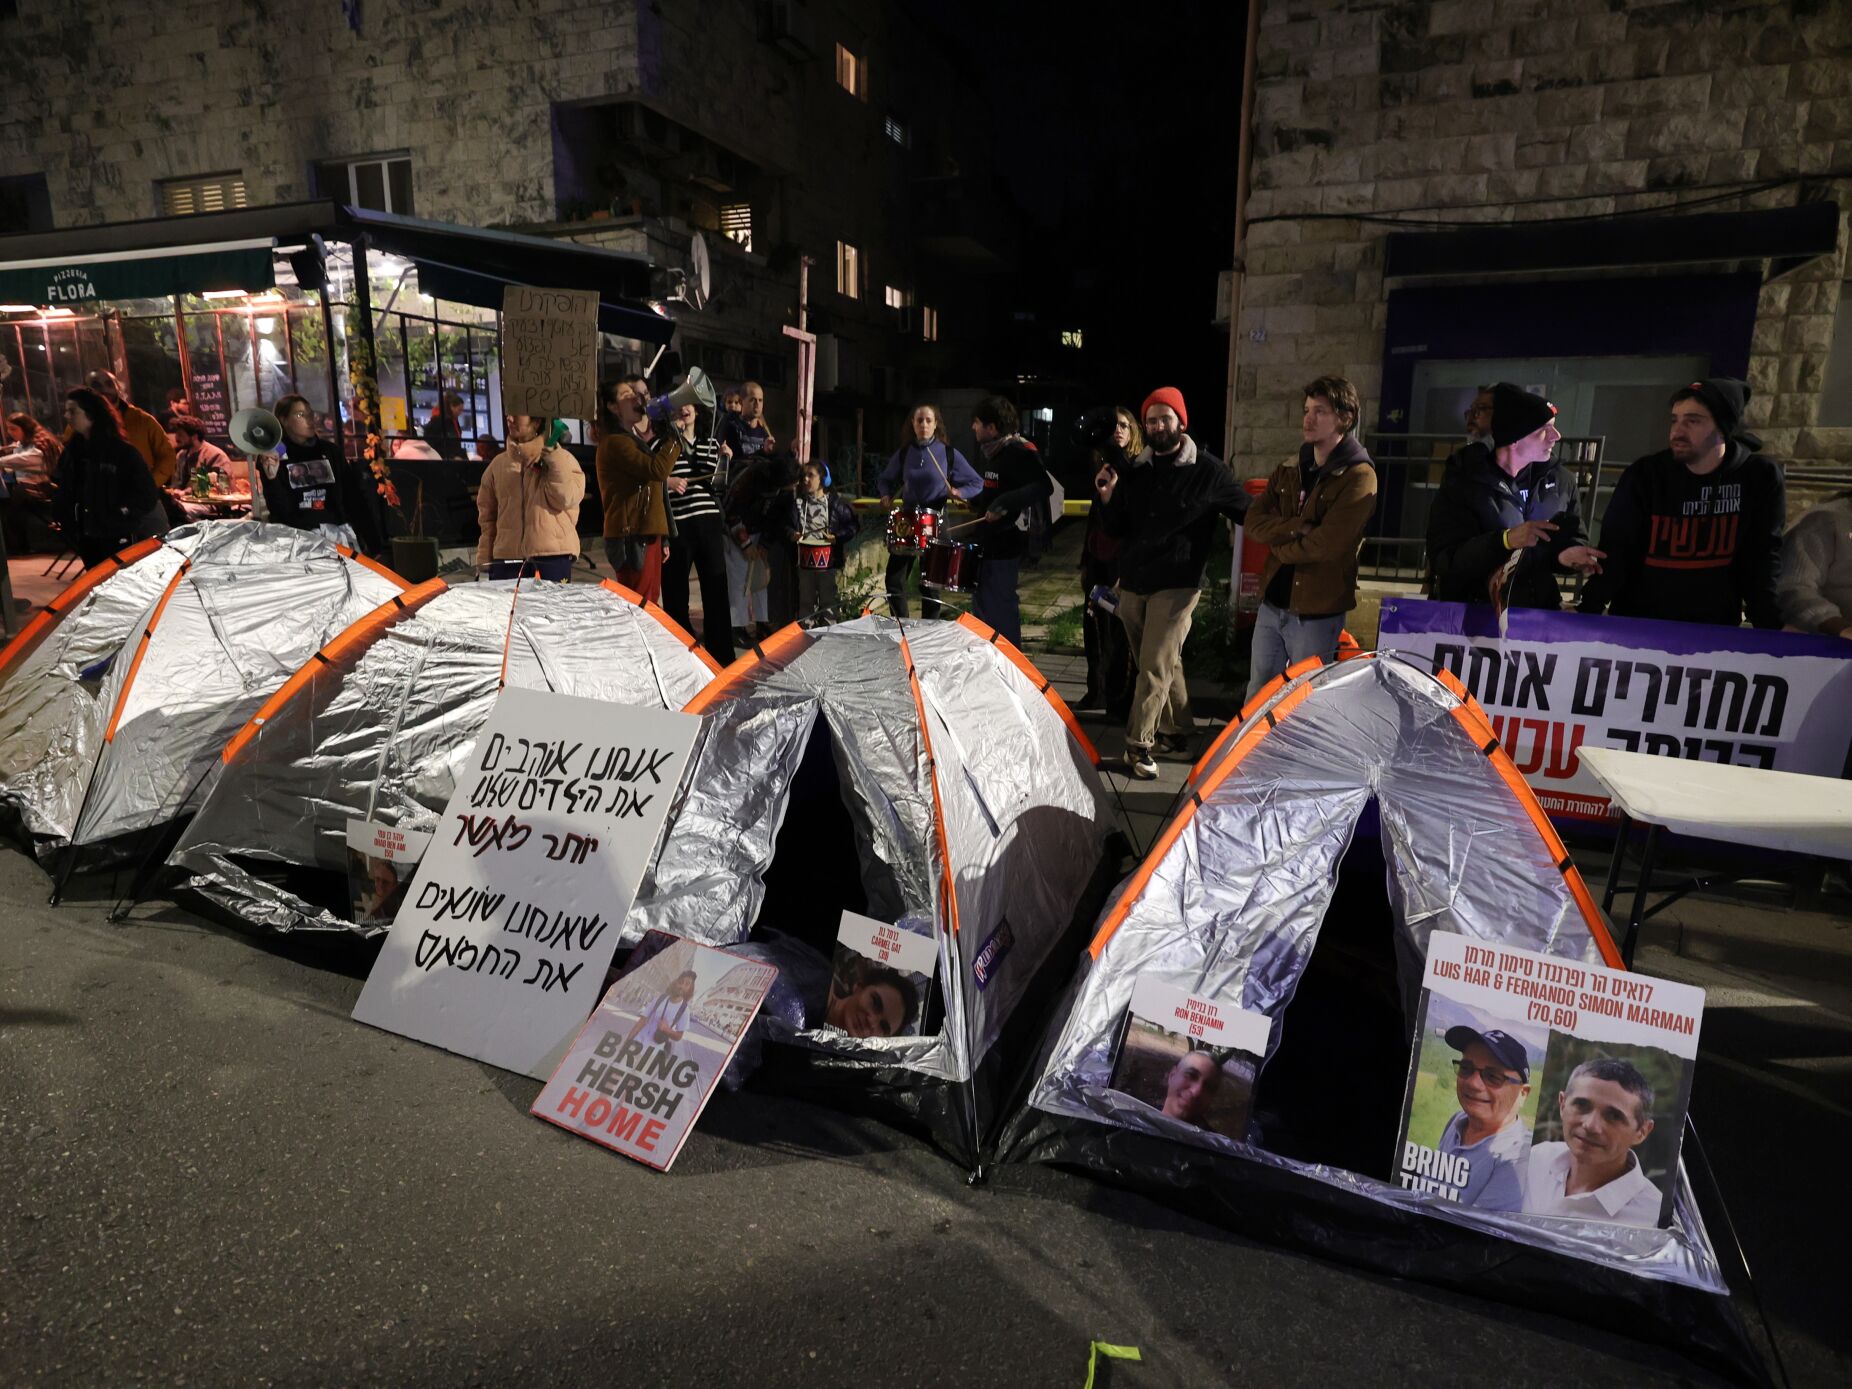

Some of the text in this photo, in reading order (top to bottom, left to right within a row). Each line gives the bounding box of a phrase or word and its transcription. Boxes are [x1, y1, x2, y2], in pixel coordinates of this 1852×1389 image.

[47, 282, 96, 300] FLORA
[53, 268, 87, 283] PIZZERIA
[1701, 483, 1741, 500] מחזיים
[1713, 497, 1741, 514] אותם
[1648, 515, 1739, 557] עכשיו
[1571, 656, 1789, 738] מחזירים
[481, 733, 674, 784] אנחנו אוהבים
[470, 772, 655, 819] את הילדים שלנו
[1566, 799, 1605, 816] להחזרת
[453, 814, 600, 864] יותר מאשר
[415, 881, 608, 951] שאנחנו שונאים
[415, 928, 584, 993] את החמאס
[871, 935, 902, 954] CARMEL GAT
[1433, 959, 1695, 1035] LUIS HAR & FERNANDO SIMON MARMAN
[1464, 945, 1654, 1003] לואיס הר ופרננדו סימון מרמן
[1174, 1007, 1225, 1031] RON BENJAMIN
[1188, 1023, 1204, 1038] (53)
[1527, 1001, 1578, 1031] (70,60)
[593, 1030, 699, 1089] BRING
[576, 1058, 684, 1120] HERSH
[556, 1086, 667, 1152] HOME
[1401, 1140, 1470, 1188] BRING
